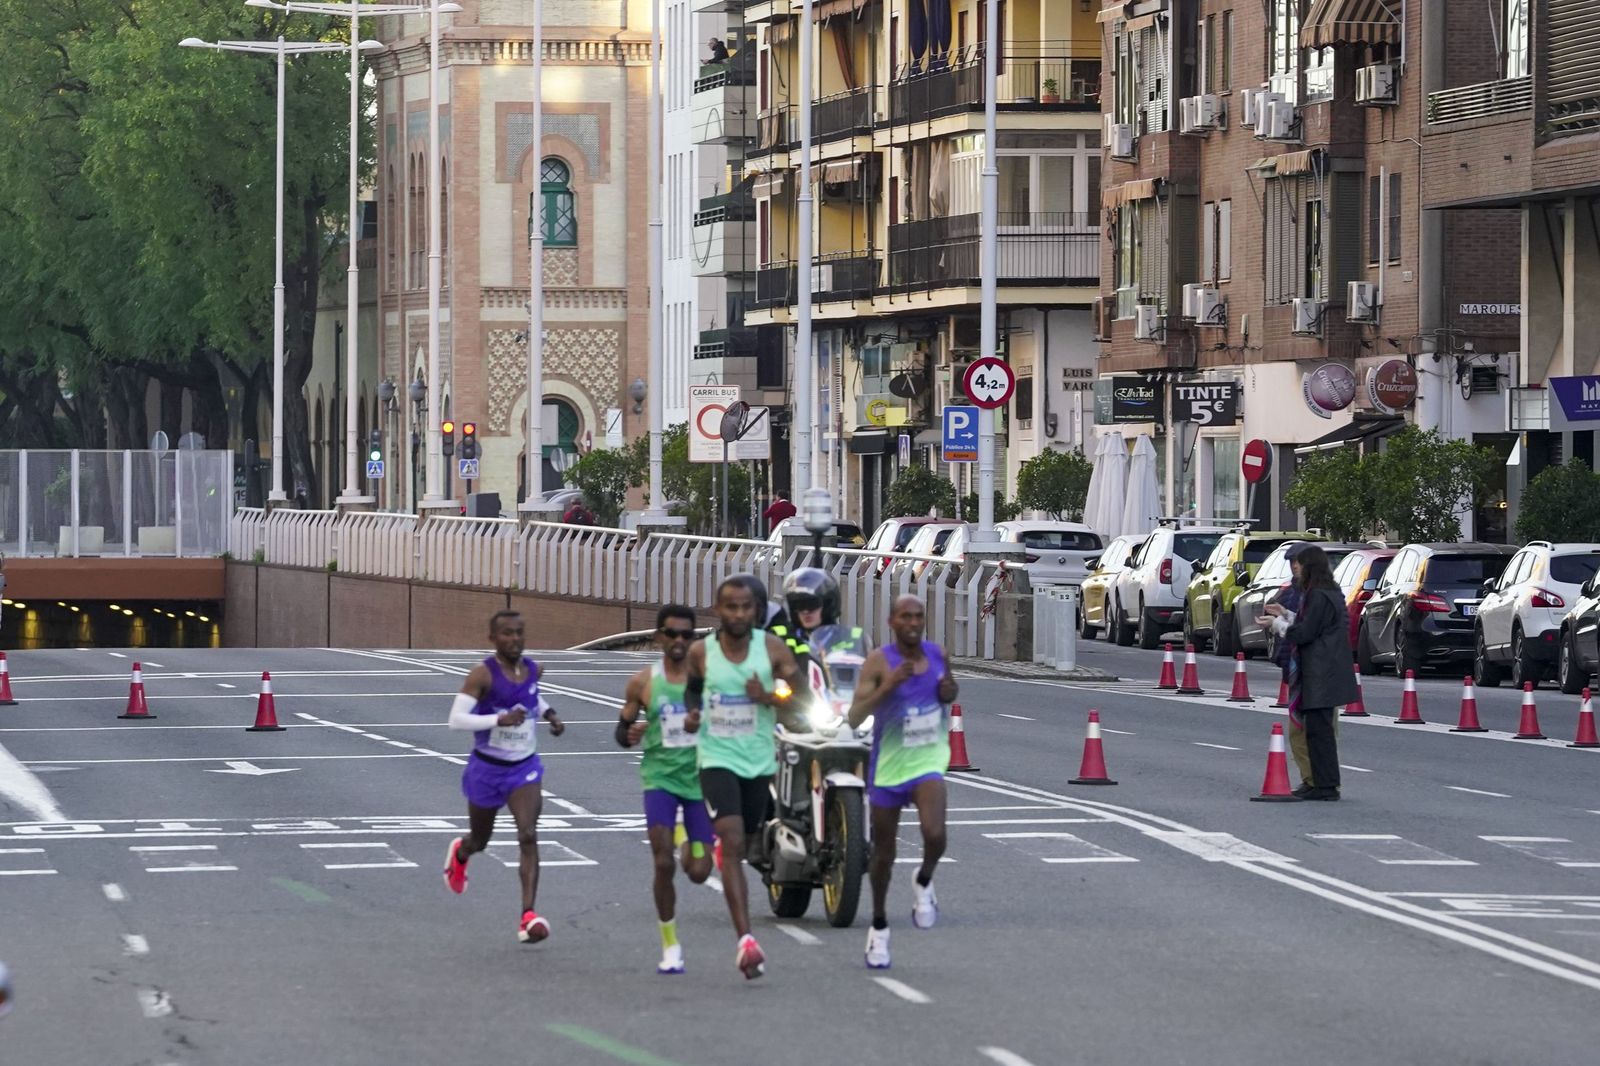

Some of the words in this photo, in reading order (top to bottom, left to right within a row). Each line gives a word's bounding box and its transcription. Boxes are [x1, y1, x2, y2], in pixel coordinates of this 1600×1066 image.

[1063, 368, 1093, 378] LUIS
[1175, 386, 1232, 400] TINTE
[1377, 382, 1416, 393] Cruzcampo
[948, 411, 970, 440] P
